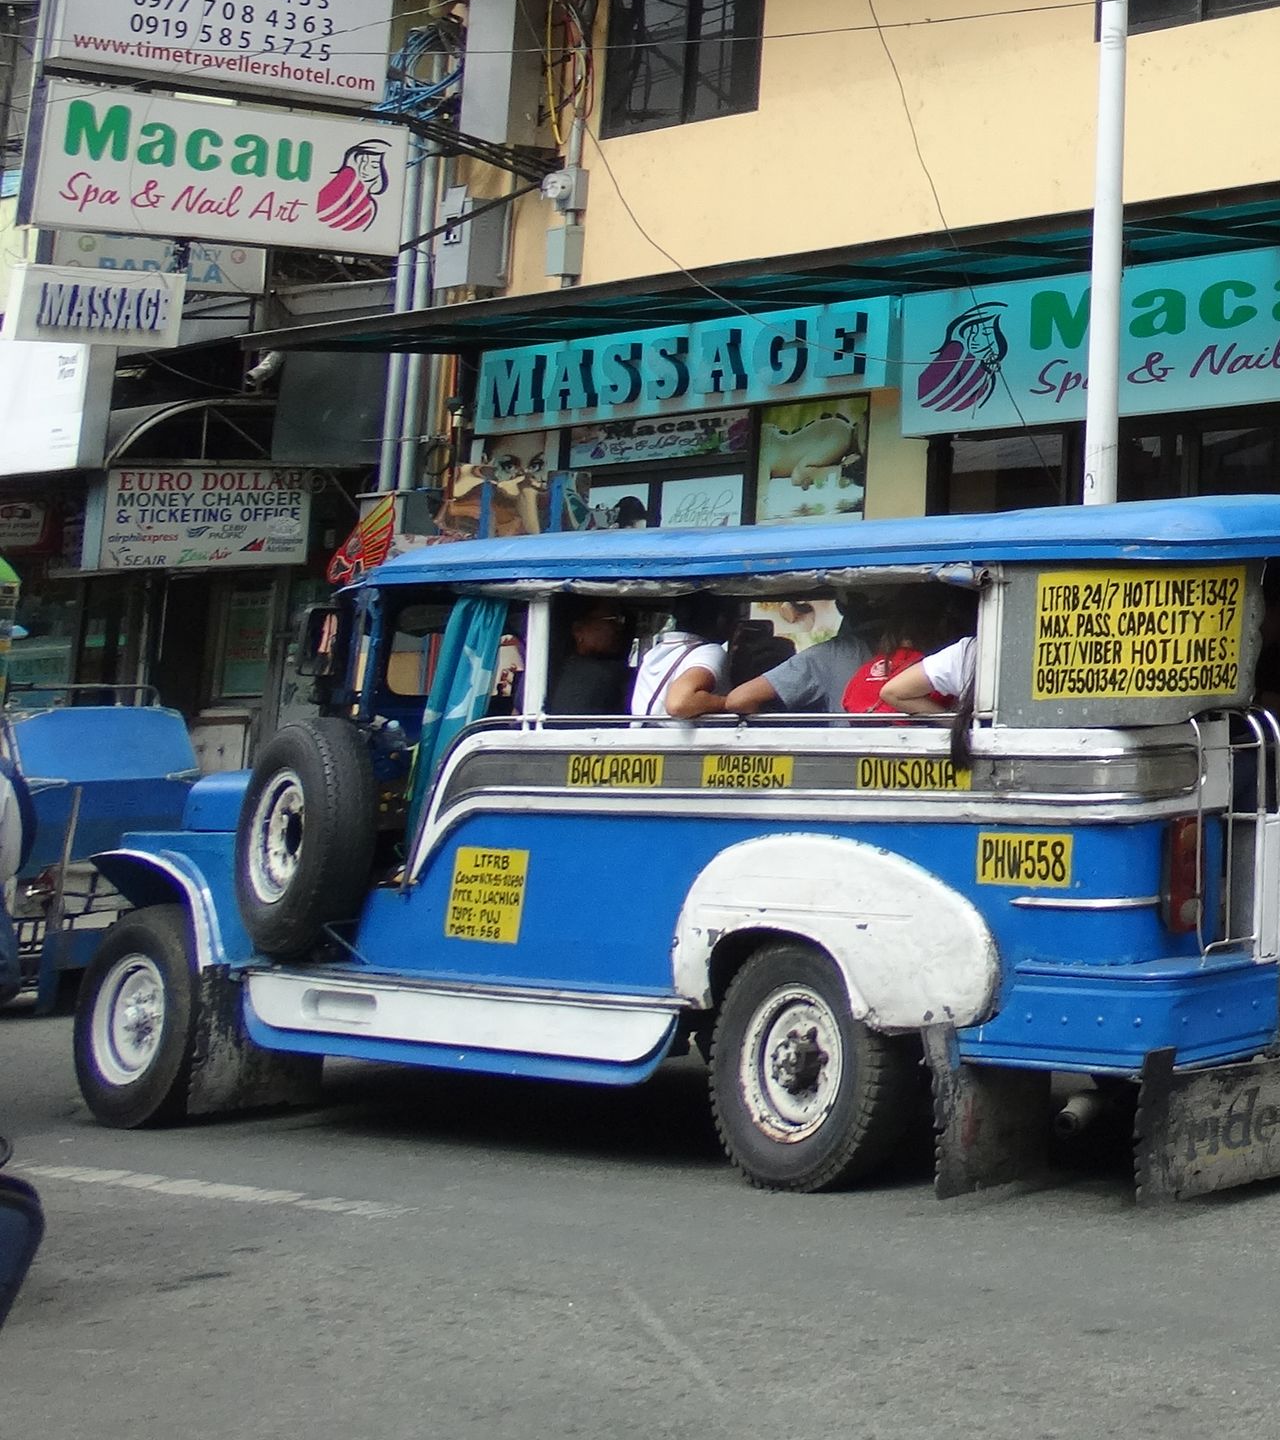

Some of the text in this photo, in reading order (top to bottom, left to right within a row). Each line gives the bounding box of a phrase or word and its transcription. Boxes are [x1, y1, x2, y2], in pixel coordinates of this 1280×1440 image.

[129, 13, 332, 62] 0919 585 5725
[265, 9, 335, 37] 4363
[73, 33, 377, 92] www.timetravellershotel.com
[64, 99, 314, 182] Macau
[58, 171, 310, 224] Spa & Nail Art
[164, 246, 222, 262] MNEY
[37, 282, 171, 331] MASSAGE
[481, 311, 868, 420] MASSAGE
[1126, 351, 1176, 384] &
[604, 417, 723, 441] Macau
[117, 471, 304, 491] EURO DOLLAR
[116, 491, 301, 508] MONEY CHANGER
[116, 507, 301, 524] & TICKETING OFFICE
[123, 554, 168, 567] SEAIR
[1041, 584, 1080, 612] LTFRB
[1082, 577, 1119, 612] 24/7
[1039, 609, 1205, 640] MAX. PASS. CAPACITY
[1038, 636, 1236, 667] TEXT/VIBER HOTLINES:
[1037, 662, 1239, 695] 09175501342/09985501342
[571, 756, 659, 787] BACLARAN
[716, 755, 775, 773] MABINI
[860, 757, 958, 790] DIVISORIA
[706, 772, 786, 789] HARRISON
[473, 853, 511, 870] LTFRB
[980, 837, 1067, 883] PHW558
[480, 908, 502, 924] PUJ
